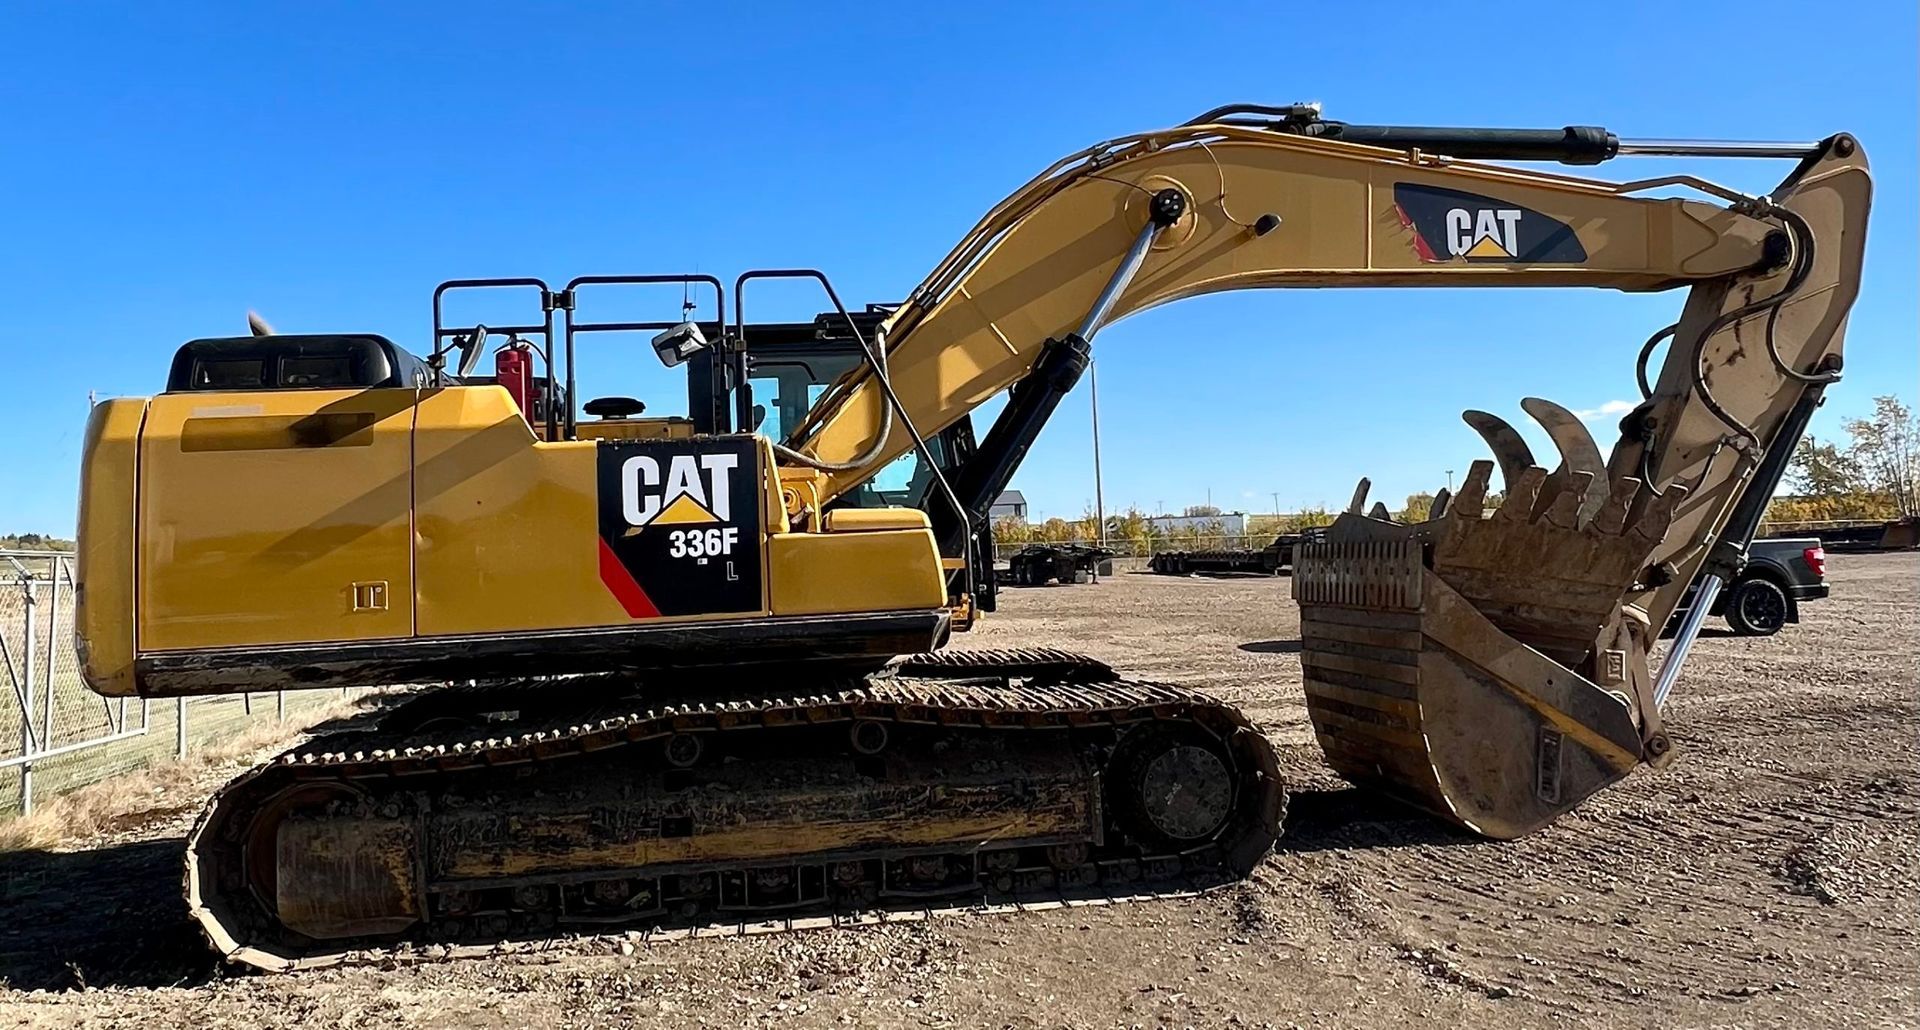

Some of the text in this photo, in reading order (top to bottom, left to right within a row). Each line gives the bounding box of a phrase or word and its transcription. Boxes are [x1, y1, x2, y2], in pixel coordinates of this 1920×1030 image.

[1446, 208, 1521, 257] CAT
[622, 453, 738, 526] CAT
[669, 527, 738, 558] 336F
[727, 561, 738, 581] L
